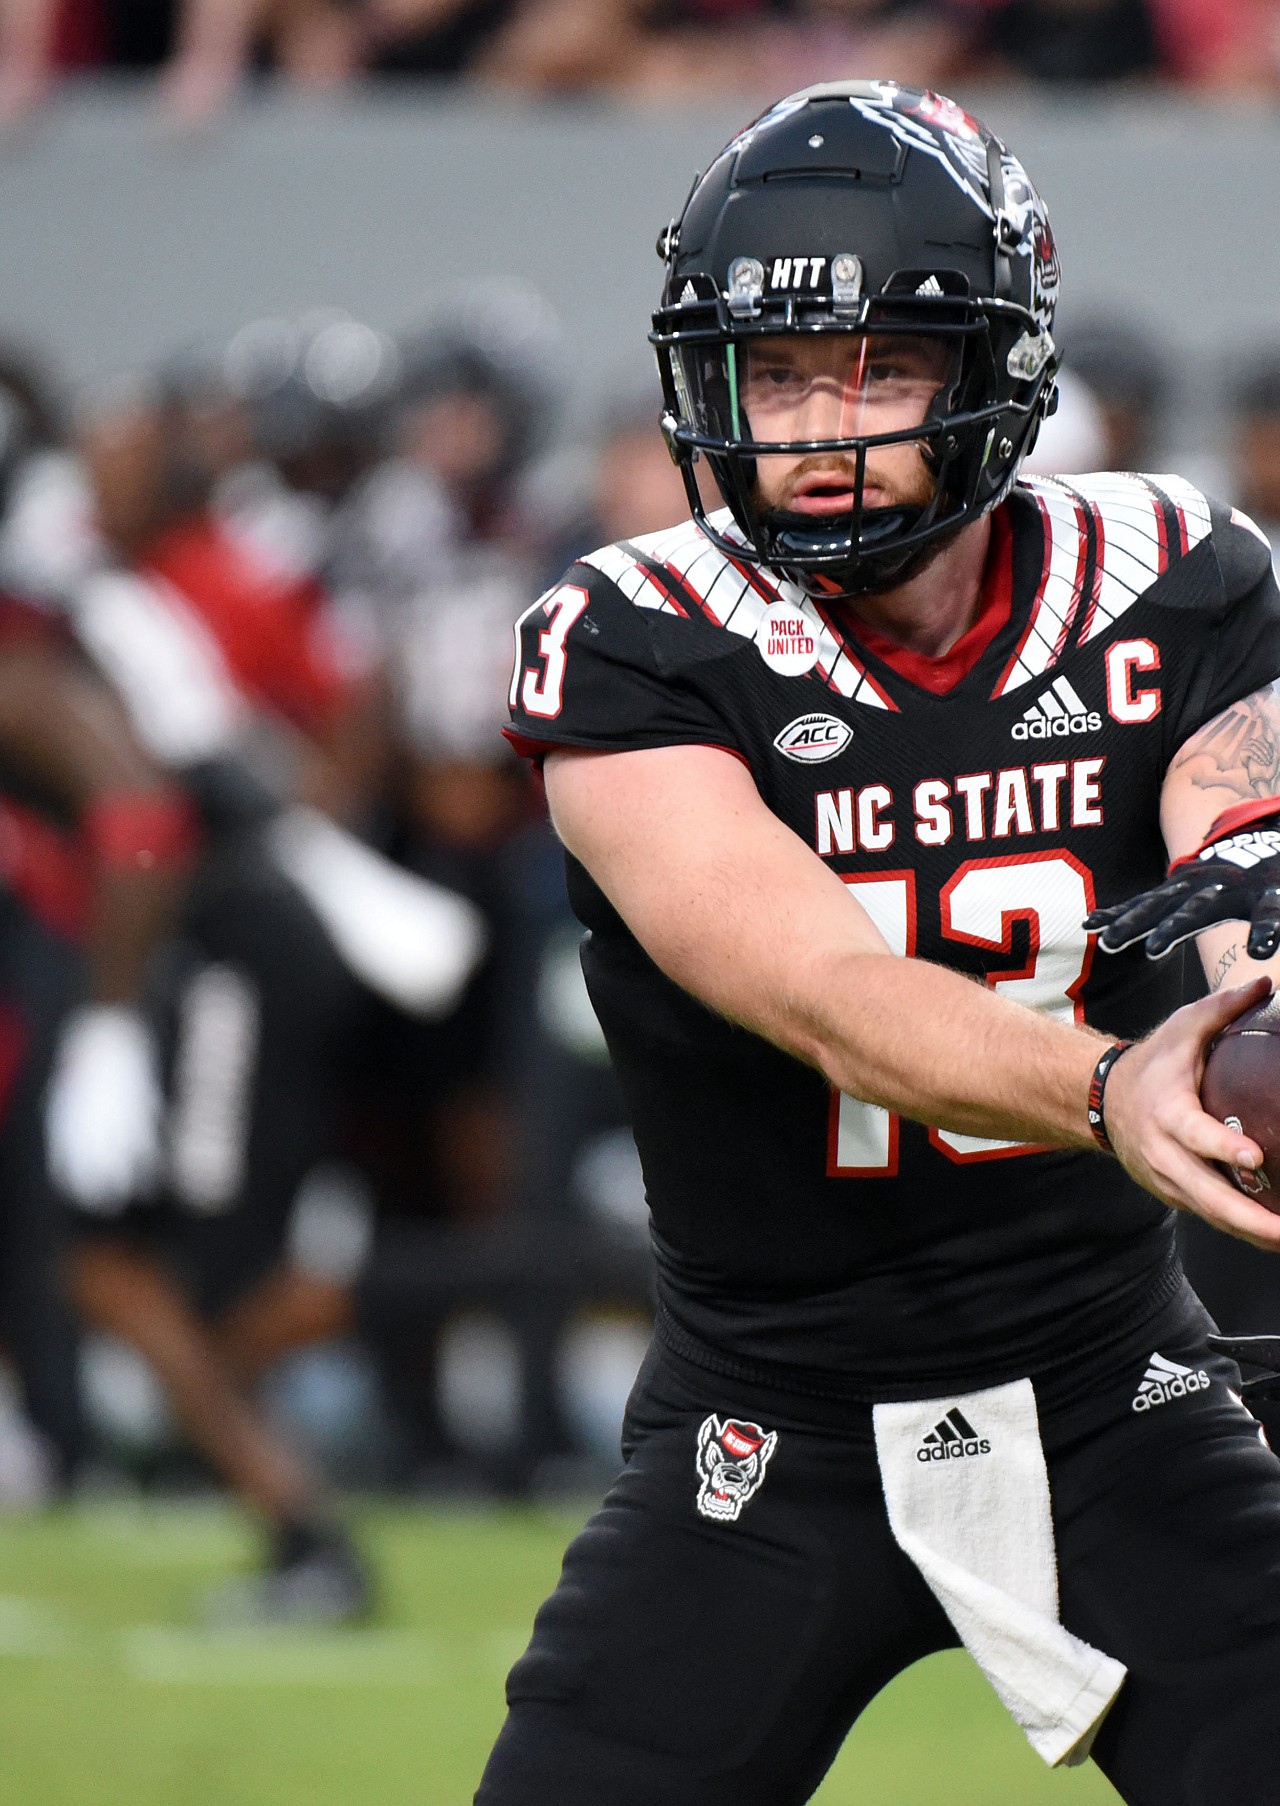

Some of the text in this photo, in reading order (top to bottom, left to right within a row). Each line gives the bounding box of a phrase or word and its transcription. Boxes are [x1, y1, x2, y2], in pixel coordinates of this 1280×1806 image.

[771, 257, 826, 289] HTT
[771, 618, 805, 637] PACK
[767, 635, 814, 656] UNITED
[1105, 637, 1162, 724] C
[789, 722, 842, 745] ACC
[1011, 710, 1102, 740] adidas
[814, 755, 1107, 857] NC STATE
[1132, 1369, 1211, 1412] adidas
[916, 1437, 992, 1463] adidas
